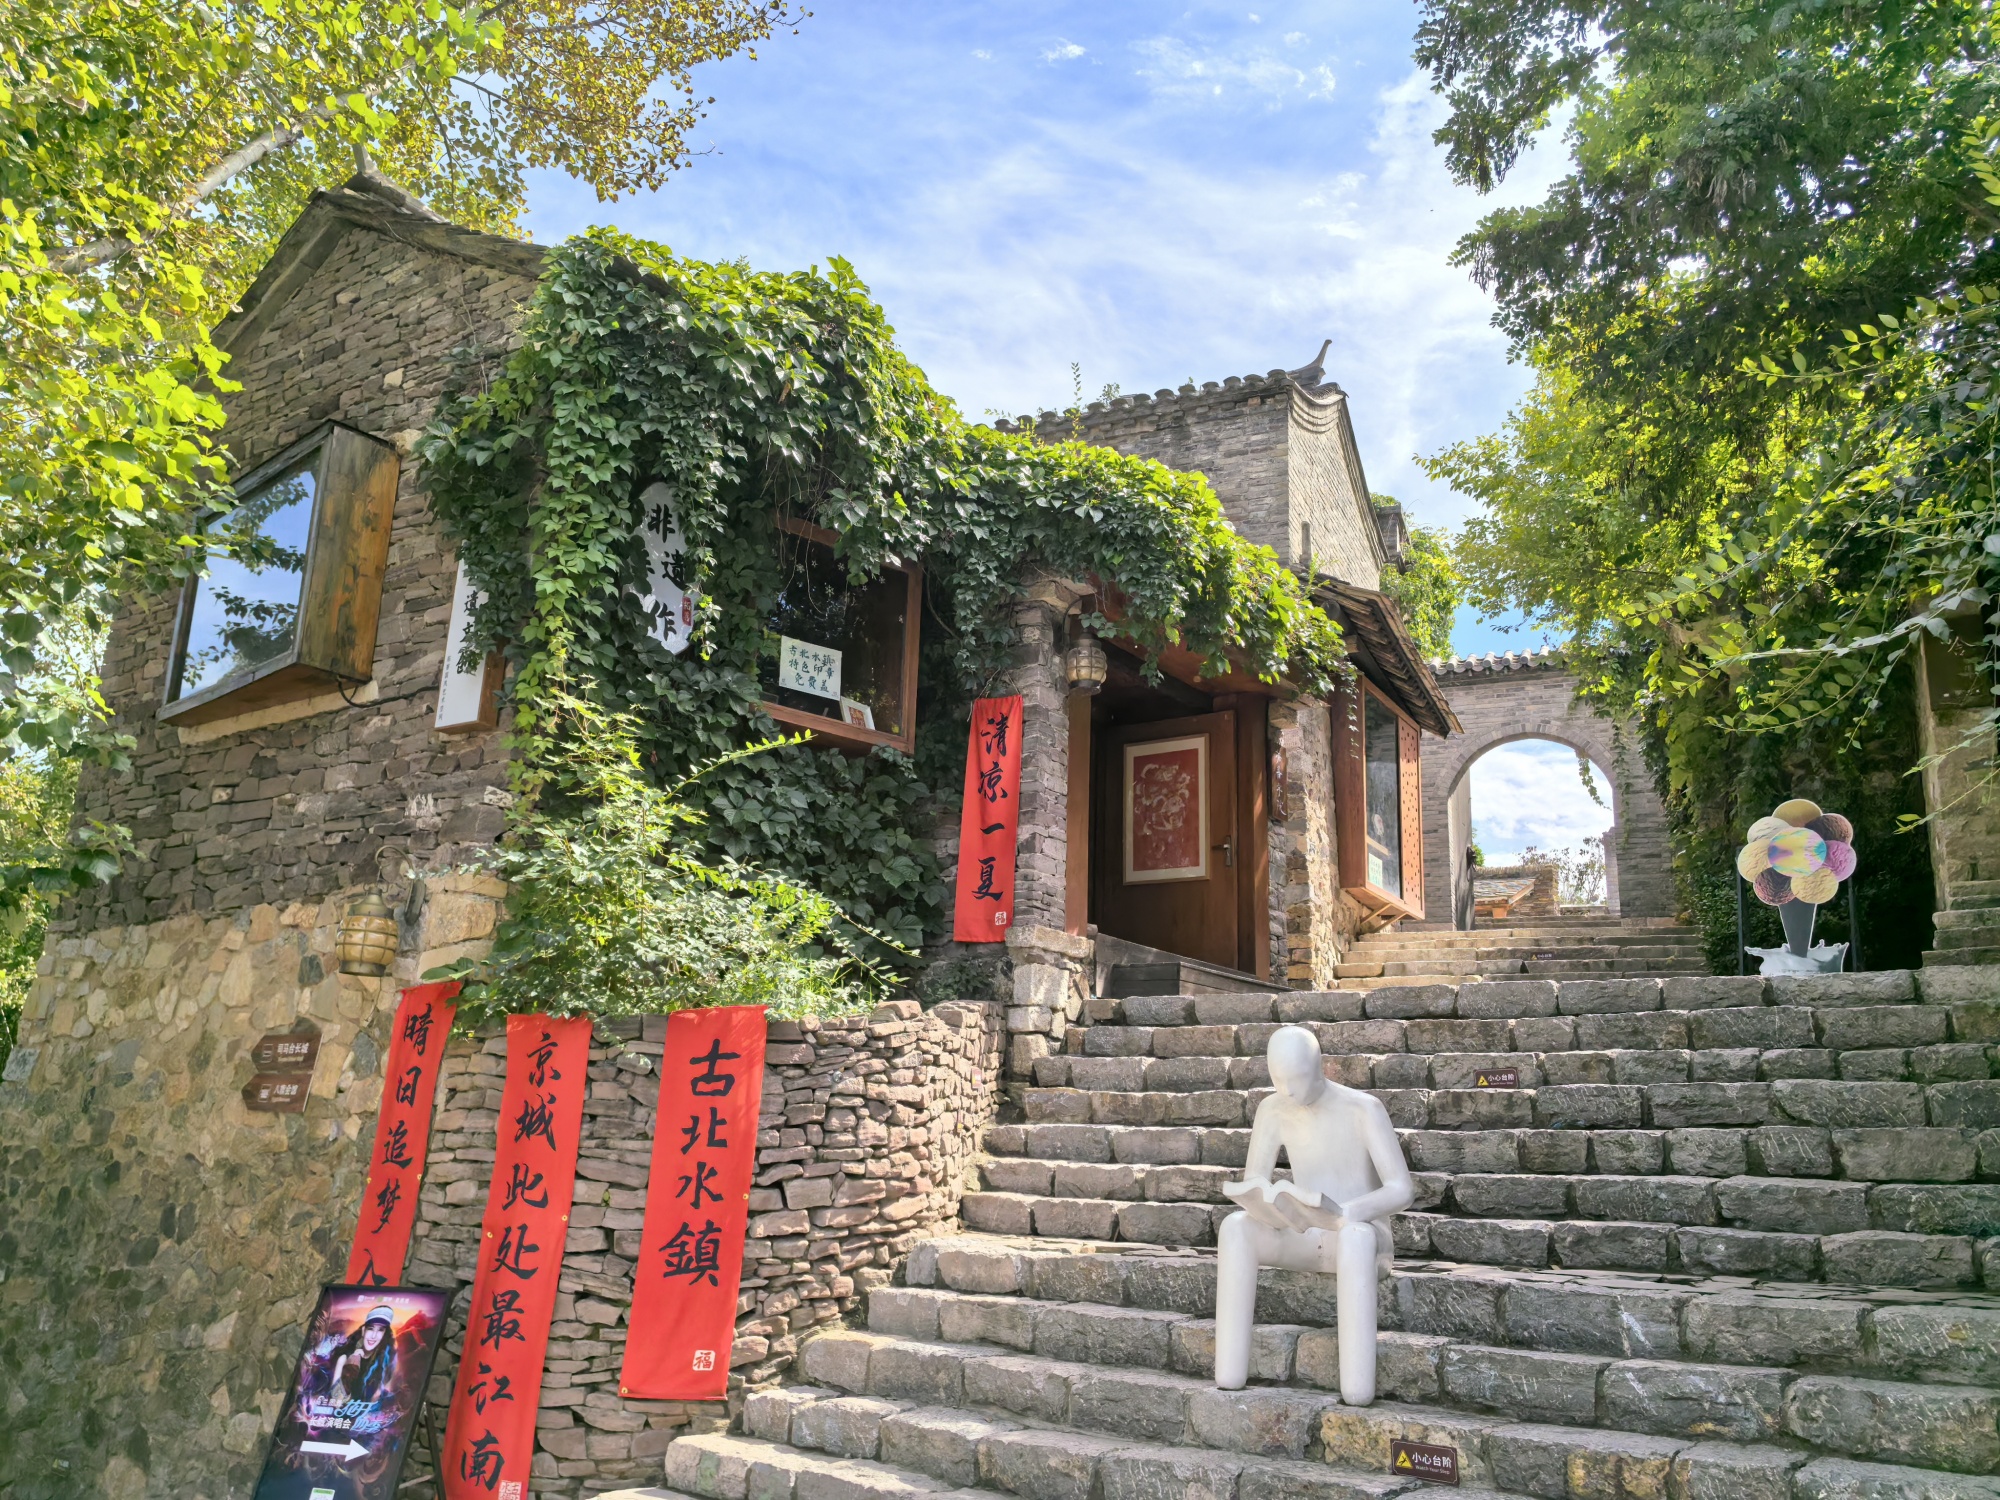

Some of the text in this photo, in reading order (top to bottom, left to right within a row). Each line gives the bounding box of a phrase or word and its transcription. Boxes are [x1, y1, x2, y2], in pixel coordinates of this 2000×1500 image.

[972, 712, 1010, 902] 清凉一夏
[1488, 1073, 1514, 1081] 小心台阶
[460, 1032, 560, 1490] 京城此处最江南
[693, 1350, 715, 1371] 福
[1412, 1452, 1452, 1468] 小心台阶
